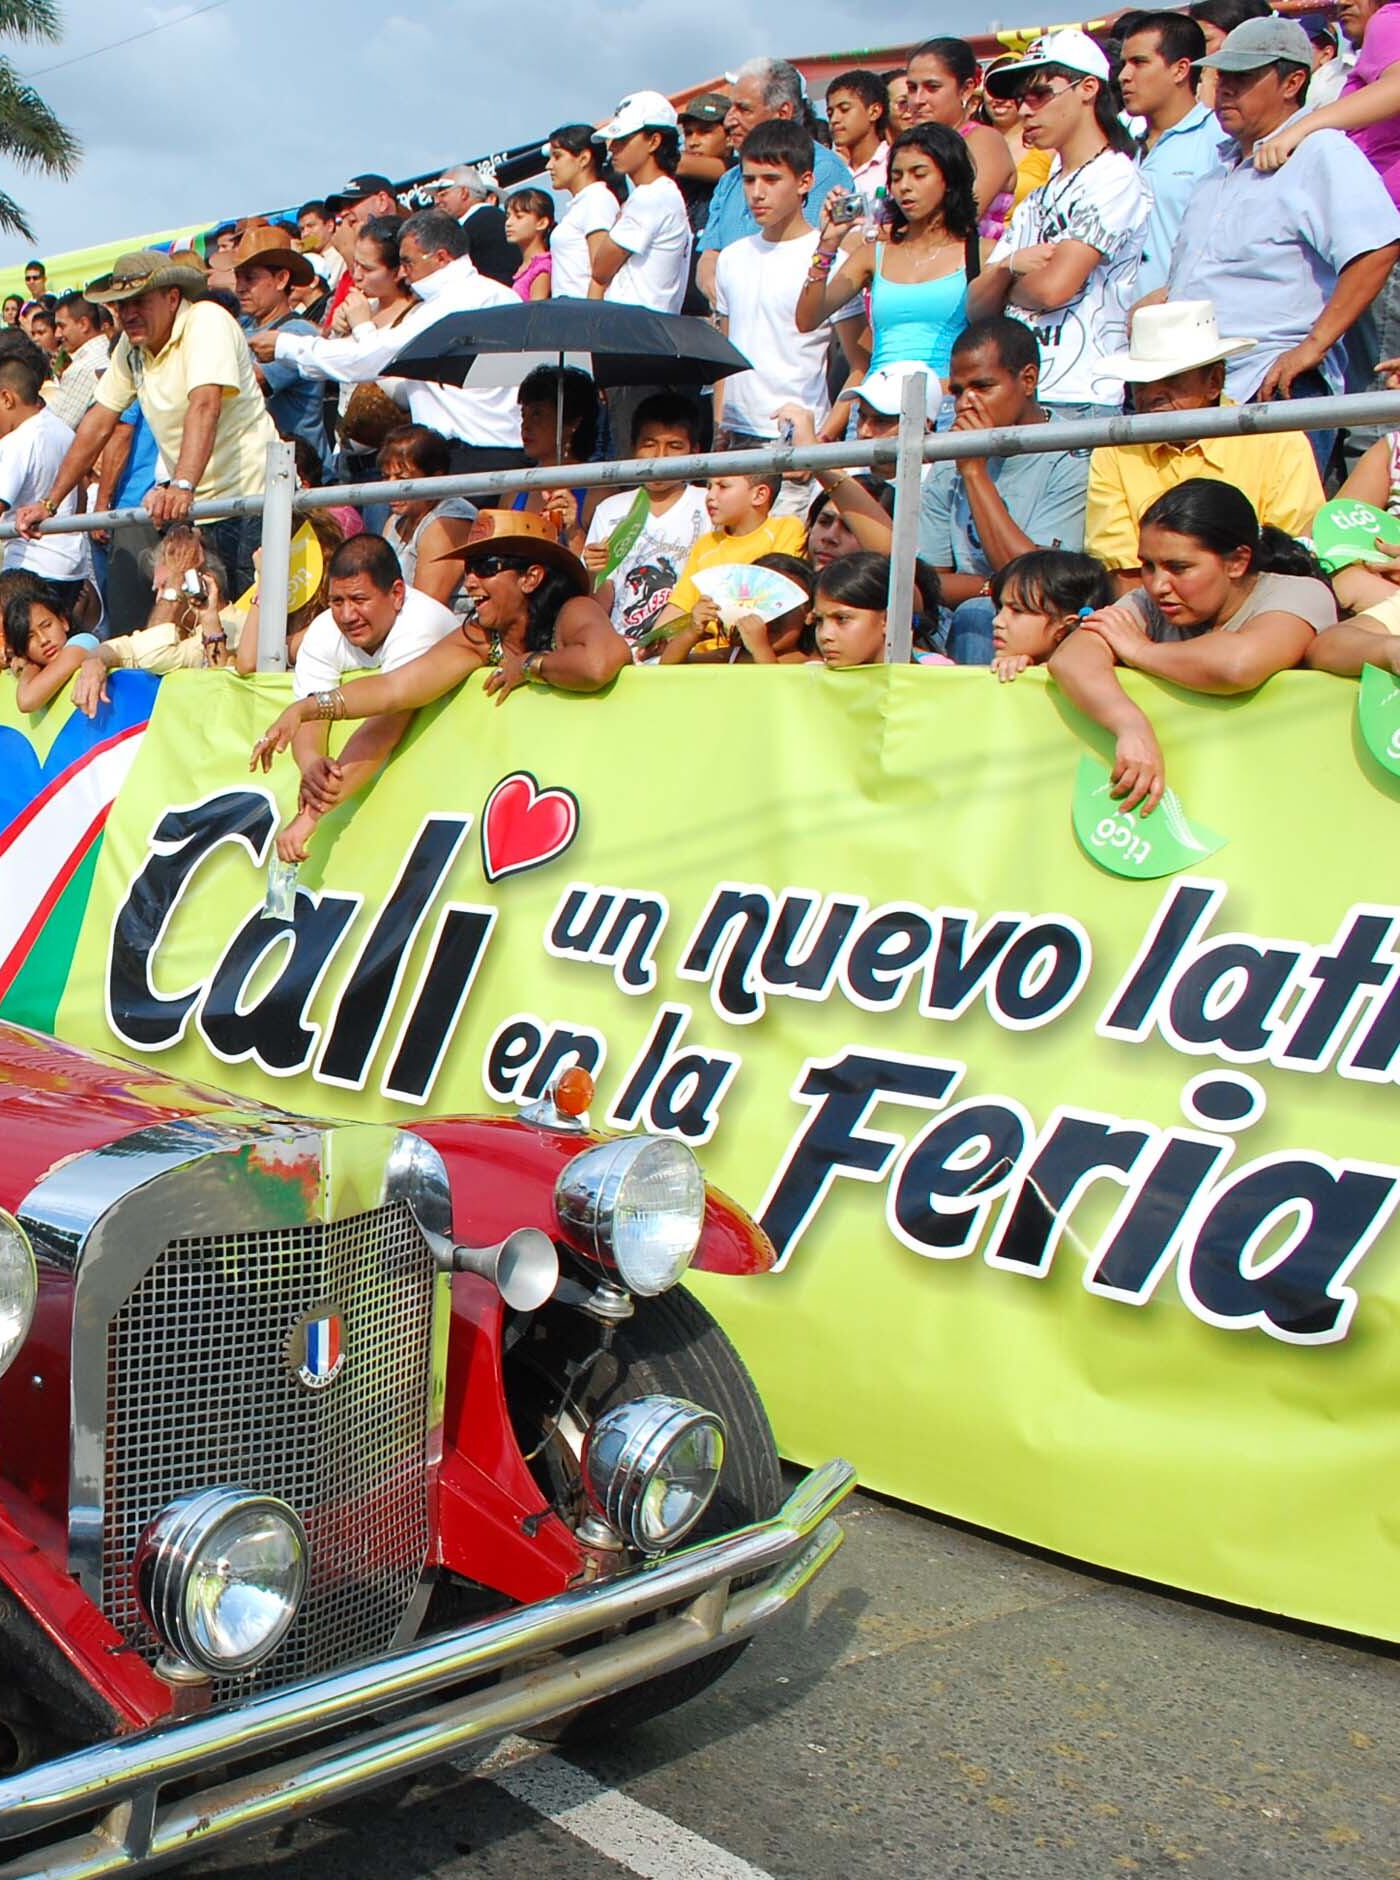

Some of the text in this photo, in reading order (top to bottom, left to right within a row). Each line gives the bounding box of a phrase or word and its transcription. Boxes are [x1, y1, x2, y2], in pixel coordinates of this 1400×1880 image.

[1330, 505, 1380, 532] tigo
[1091, 813, 1152, 865] tigo
[106, 774, 578, 1106] Cali
[546, 882, 666, 990] un
[680, 884, 1087, 1024] nuevo
[485, 1006, 1400, 1339] en la Feria
